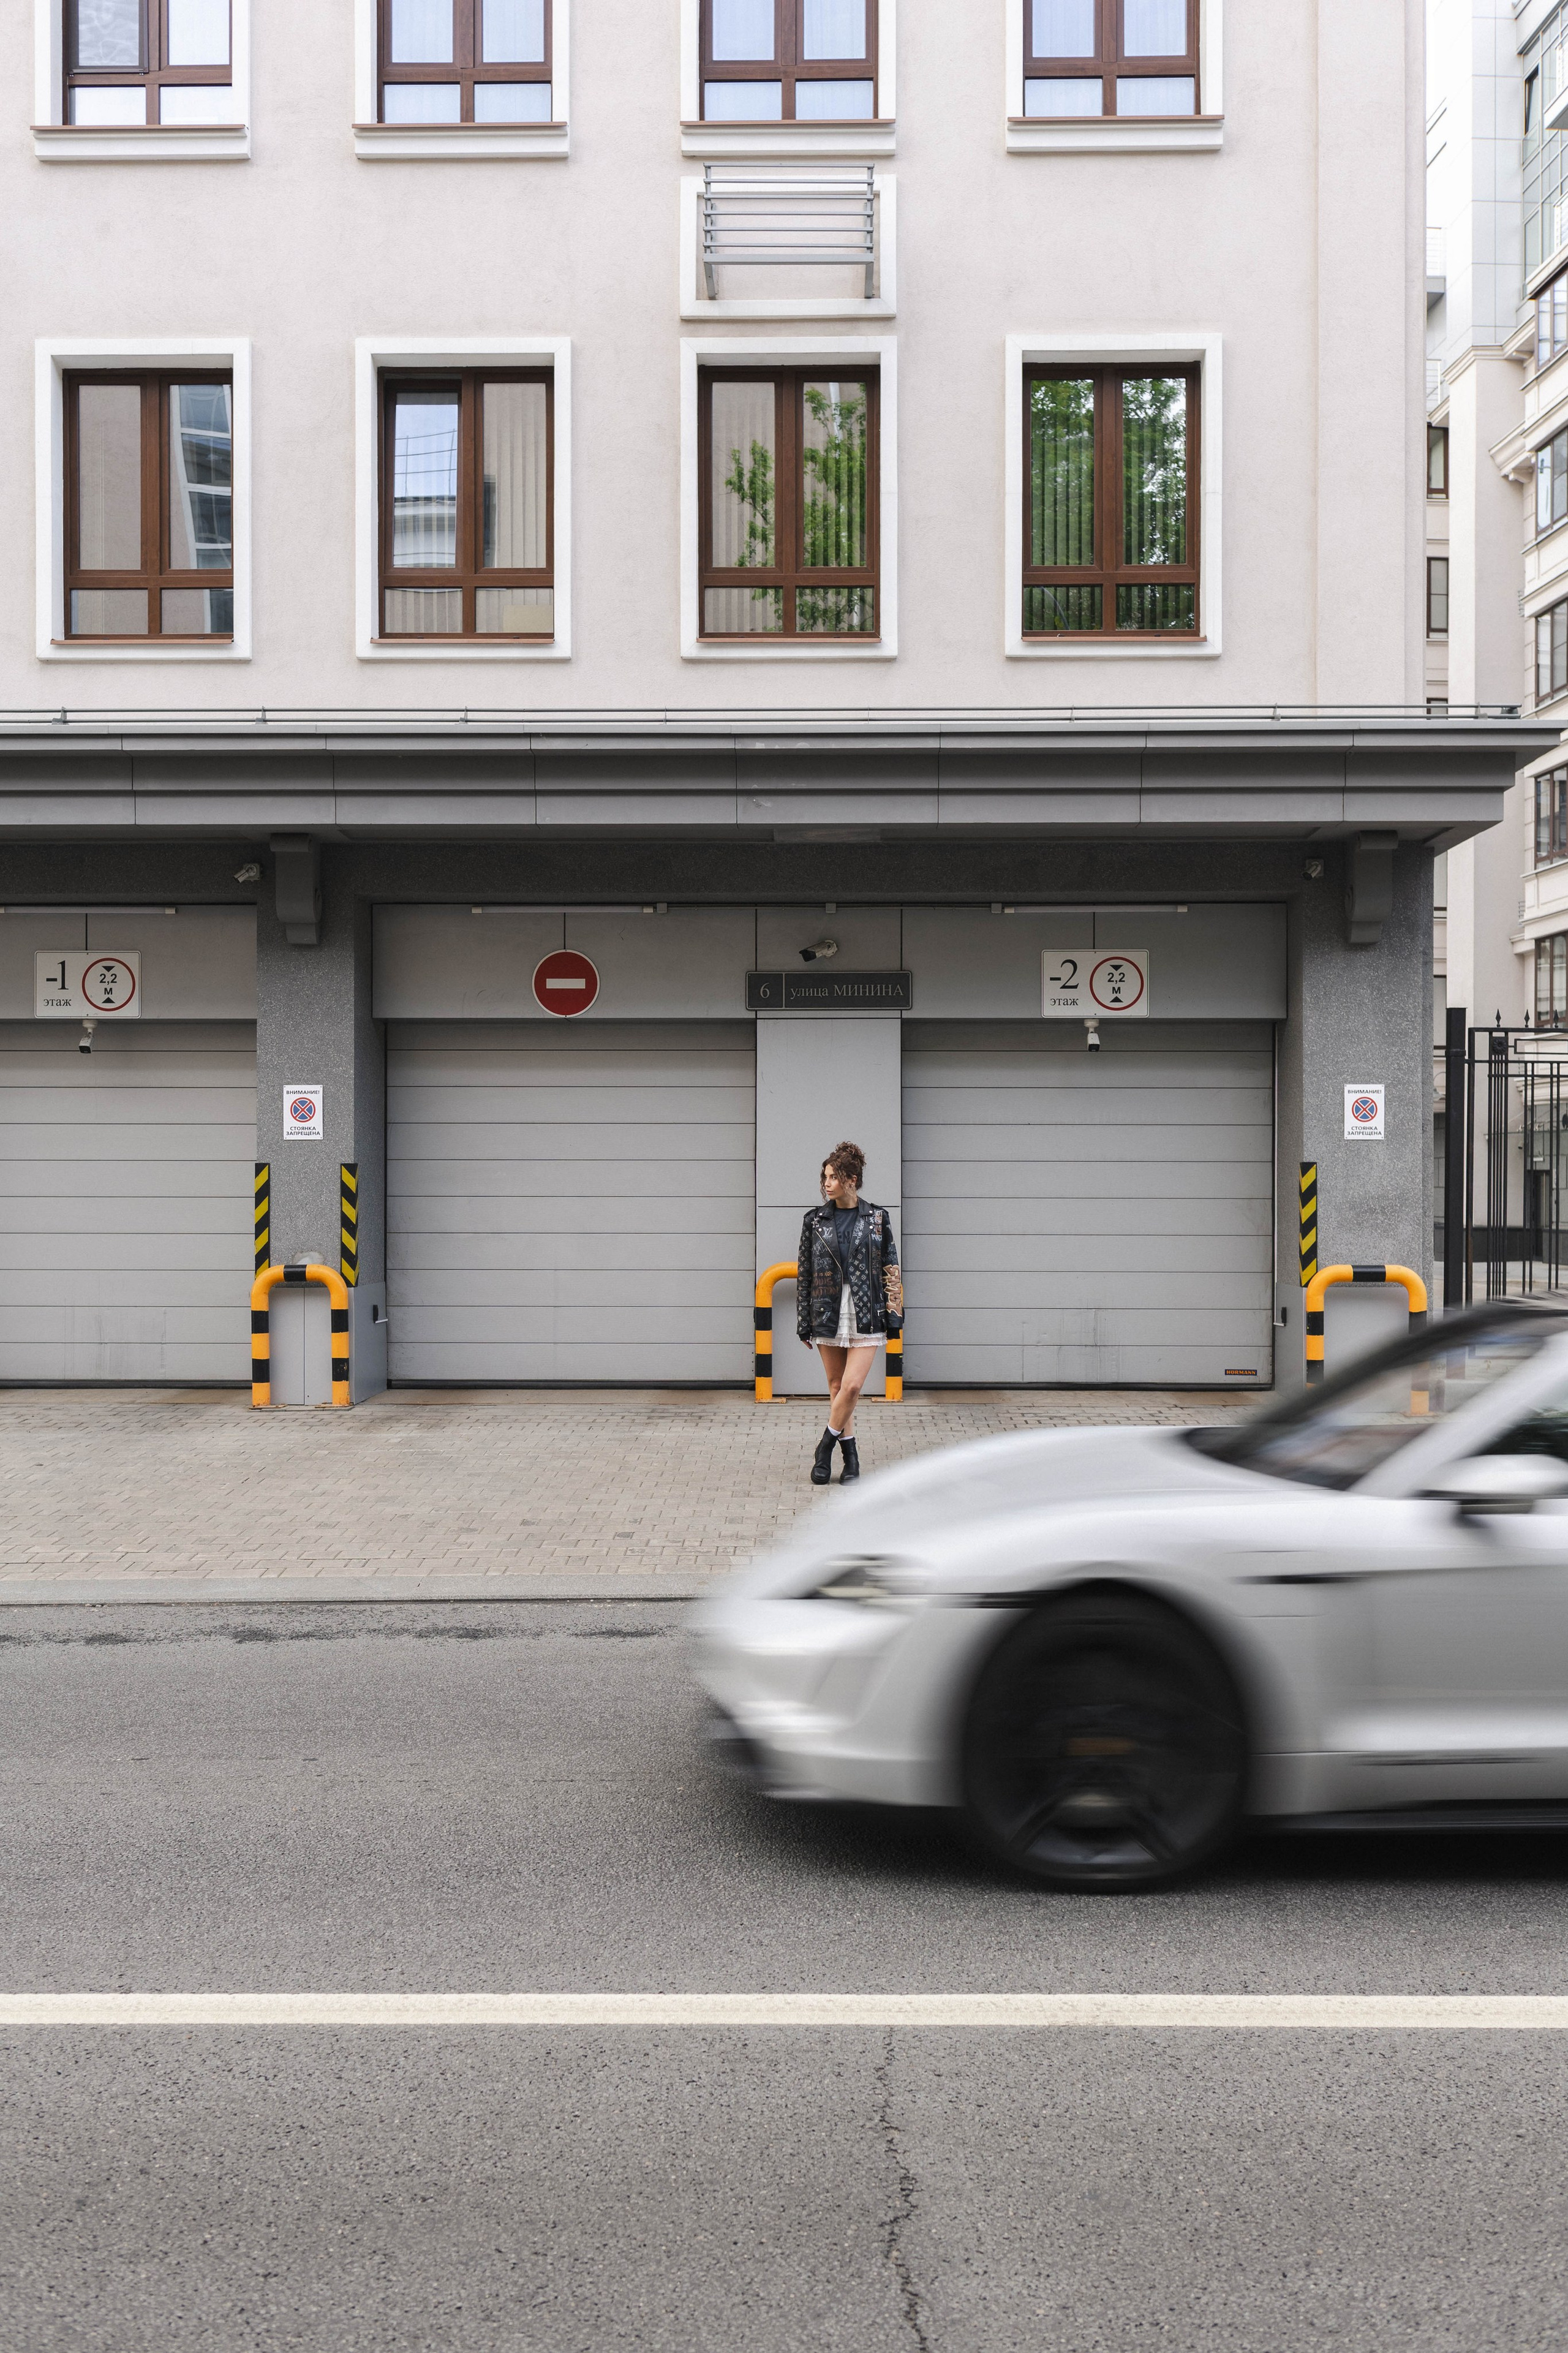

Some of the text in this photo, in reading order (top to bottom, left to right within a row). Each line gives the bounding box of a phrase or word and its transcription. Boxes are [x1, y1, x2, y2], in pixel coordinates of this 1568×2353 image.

[46, 960, 69, 990] -1
[99, 973, 117, 985] 2,2
[1050, 959, 1079, 989] -2
[1107, 973, 1125, 984] 2,2
[760, 982, 904, 1000] 6 улица МИНИНА
[43, 998, 72, 1007] этаж
[1050, 997, 1079, 1006] этаж
